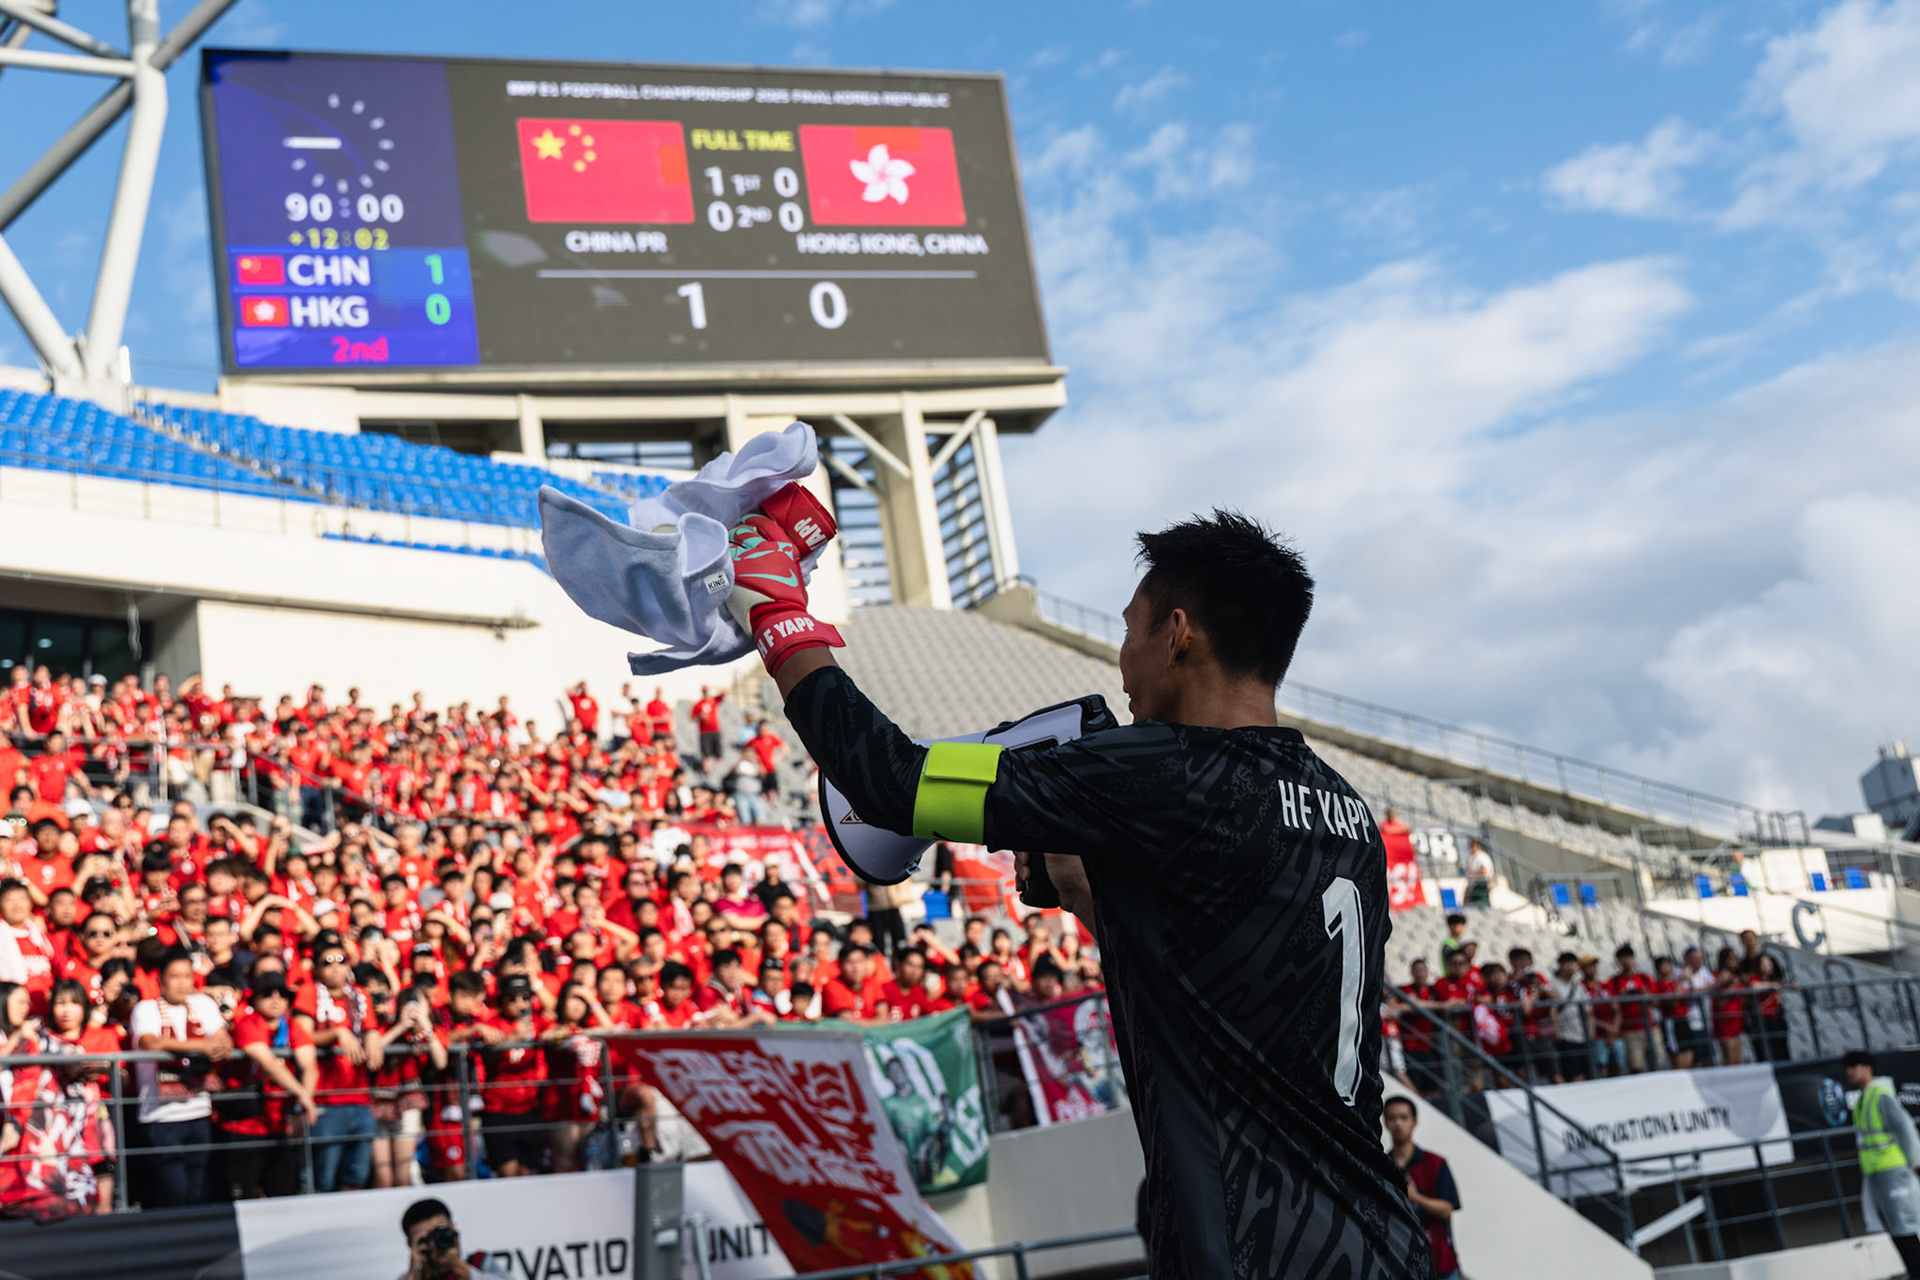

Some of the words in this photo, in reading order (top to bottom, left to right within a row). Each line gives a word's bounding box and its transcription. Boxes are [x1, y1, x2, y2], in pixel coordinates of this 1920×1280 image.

[691, 128, 744, 150] FULL
[742, 129, 795, 152] TIME
[704, 166, 724, 197] 1
[773, 167, 799, 198] 0
[707, 200, 734, 232] 0
[778, 201, 804, 233] 0
[565, 230, 636, 253] CHINA
[636, 231, 668, 253] PR
[796, 232, 860, 254] HONG
[860, 232, 925, 257] KONG,
[923, 233, 989, 255] CHINA
[287, 254, 371, 286] CHN
[424, 254, 444, 285] 1
[290, 295, 369, 327] HKG
[425, 293, 451, 325] 0
[677, 281, 707, 329] 1
[809, 281, 848, 329] 0
[331, 335, 389, 362] 2nd
[794, 517, 828, 550] APP
[708, 577, 726, 590] KING
[763, 628, 774, 648] F
[773, 617, 815, 638] YAPP
[1316, 789, 1370, 844] YAPP
[1793, 899, 1824, 949] C
[1322, 877, 1365, 1107] 1
